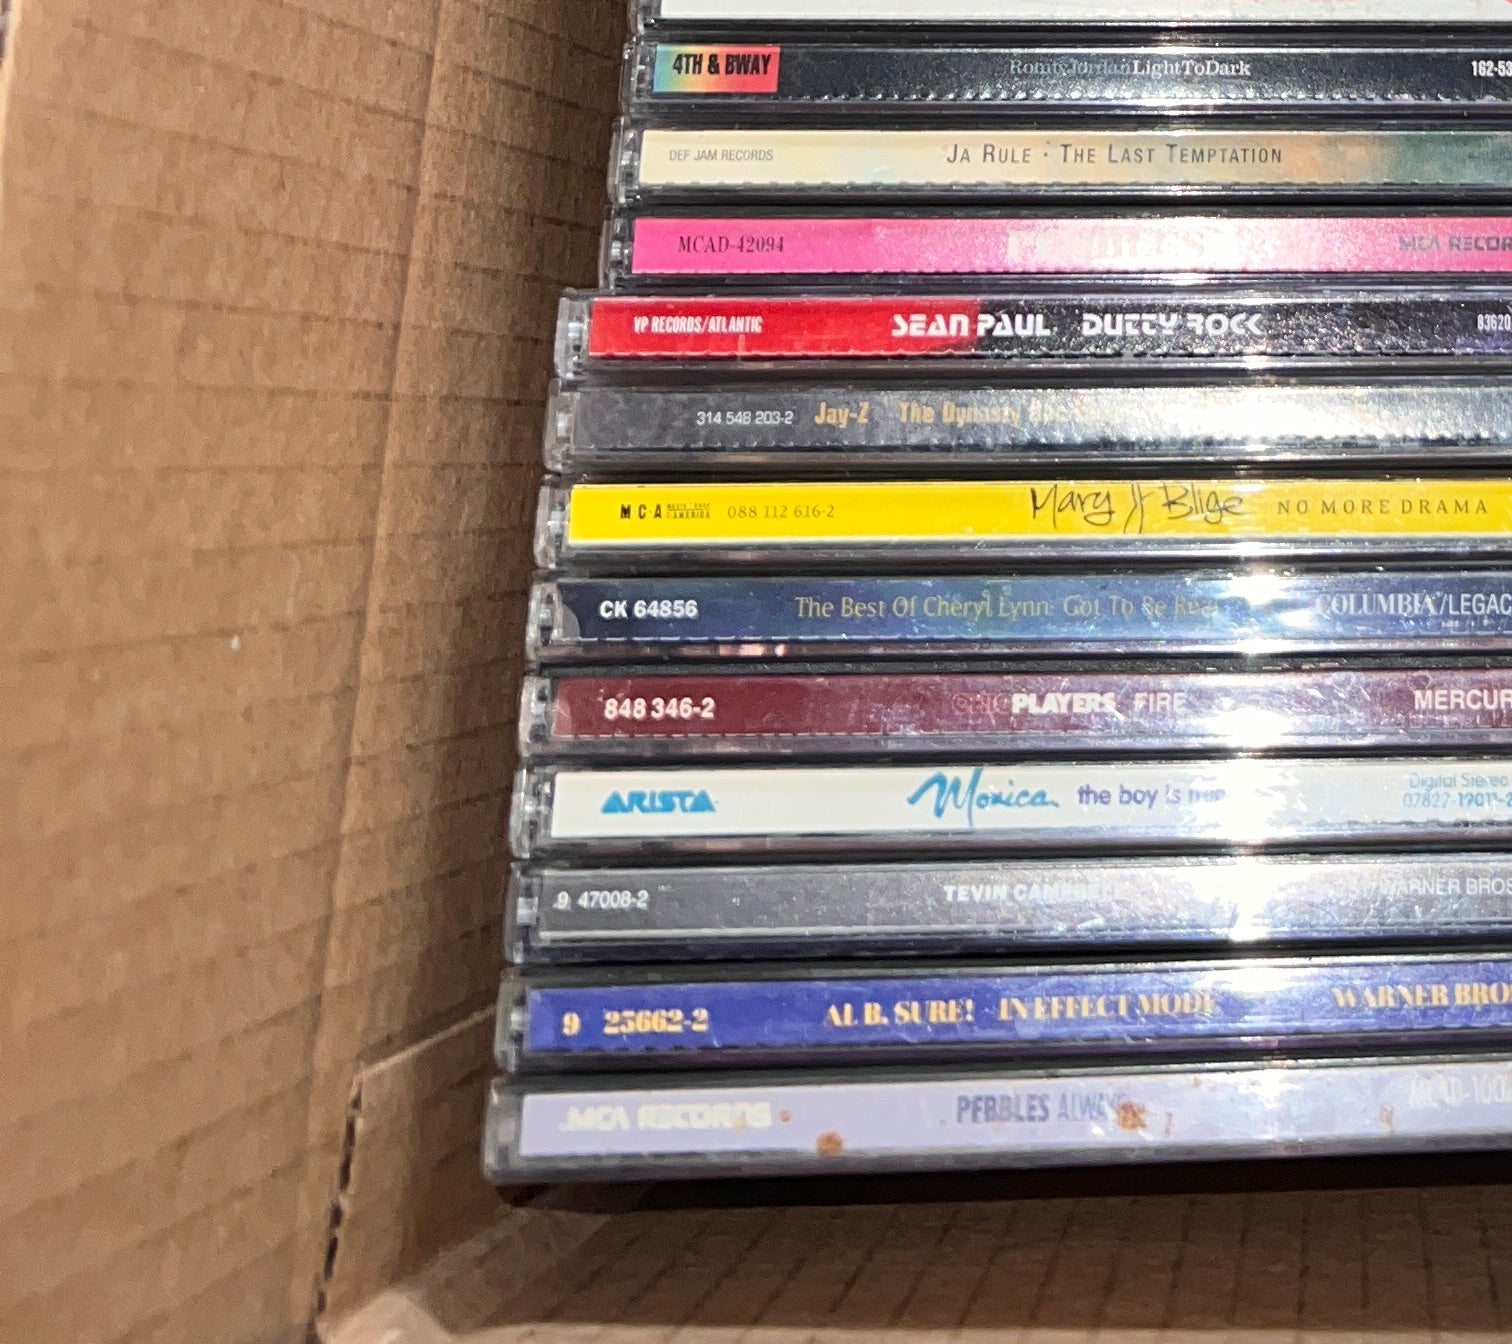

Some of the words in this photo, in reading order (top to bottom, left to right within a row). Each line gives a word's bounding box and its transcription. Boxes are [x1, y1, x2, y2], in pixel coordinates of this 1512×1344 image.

[672, 55, 703, 76] 4TH
[669, 149, 691, 162] DEF
[694, 149, 717, 162] JAM
[720, 149, 774, 162] RECORDS
[678, 236, 785, 254] MCAD-42094
[890, 314, 969, 337] SEAN
[1081, 312, 1179, 336] DUTTY
[696, 410, 722, 425] 314
[754, 410, 794, 425] 203-2
[814, 402, 871, 427] Jay-Z
[1277, 499, 1310, 514] NO
[1321, 499, 1390, 515] MORE
[1400, 499, 1488, 514] DRAMA
[599, 600, 629, 619] CK
[633, 600, 698, 618] 64856
[604, 697, 646, 720] 848
[651, 698, 716, 720] 346-2
[600, 791, 718, 813] ARISTA
[1077, 785, 1111, 805] the
[1118, 785, 1157, 809] boy
[578, 890, 648, 910] 47008-2
[604, 1007, 709, 1033] 25662-2
